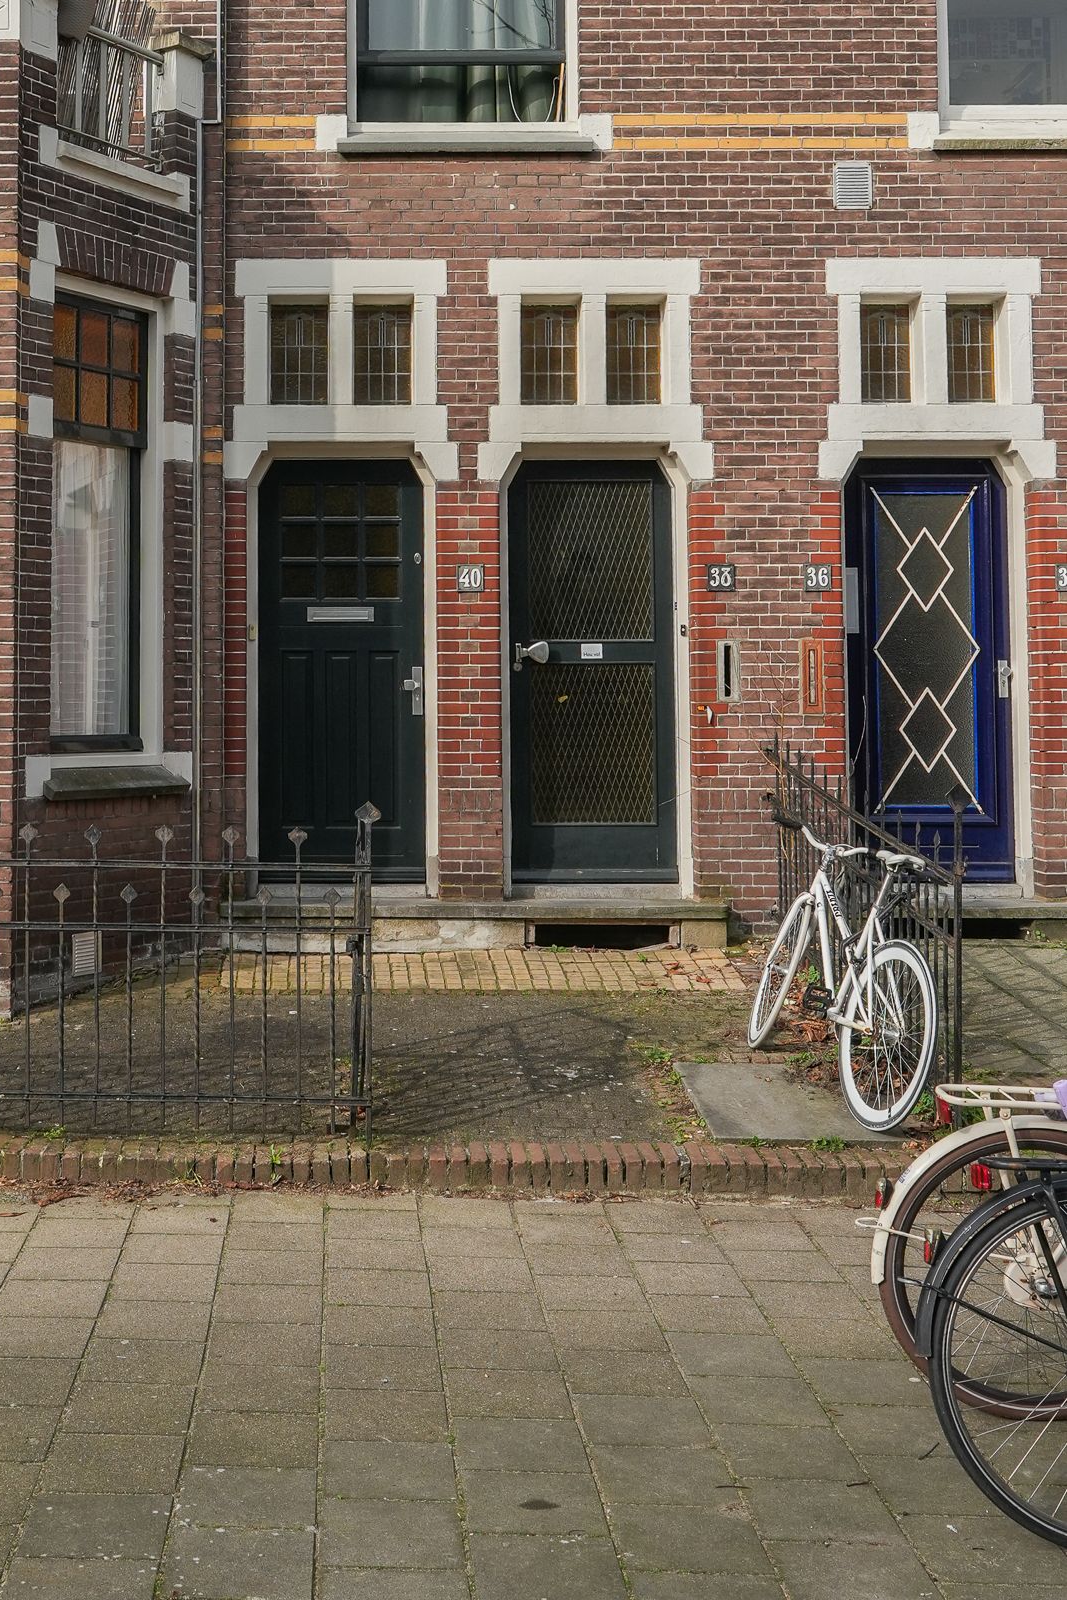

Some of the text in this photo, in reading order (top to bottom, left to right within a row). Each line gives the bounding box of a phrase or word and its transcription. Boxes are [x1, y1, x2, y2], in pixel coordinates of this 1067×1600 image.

[459, 568, 481, 588] 40
[709, 567, 732, 587] 38
[806, 567, 829, 587] 36
